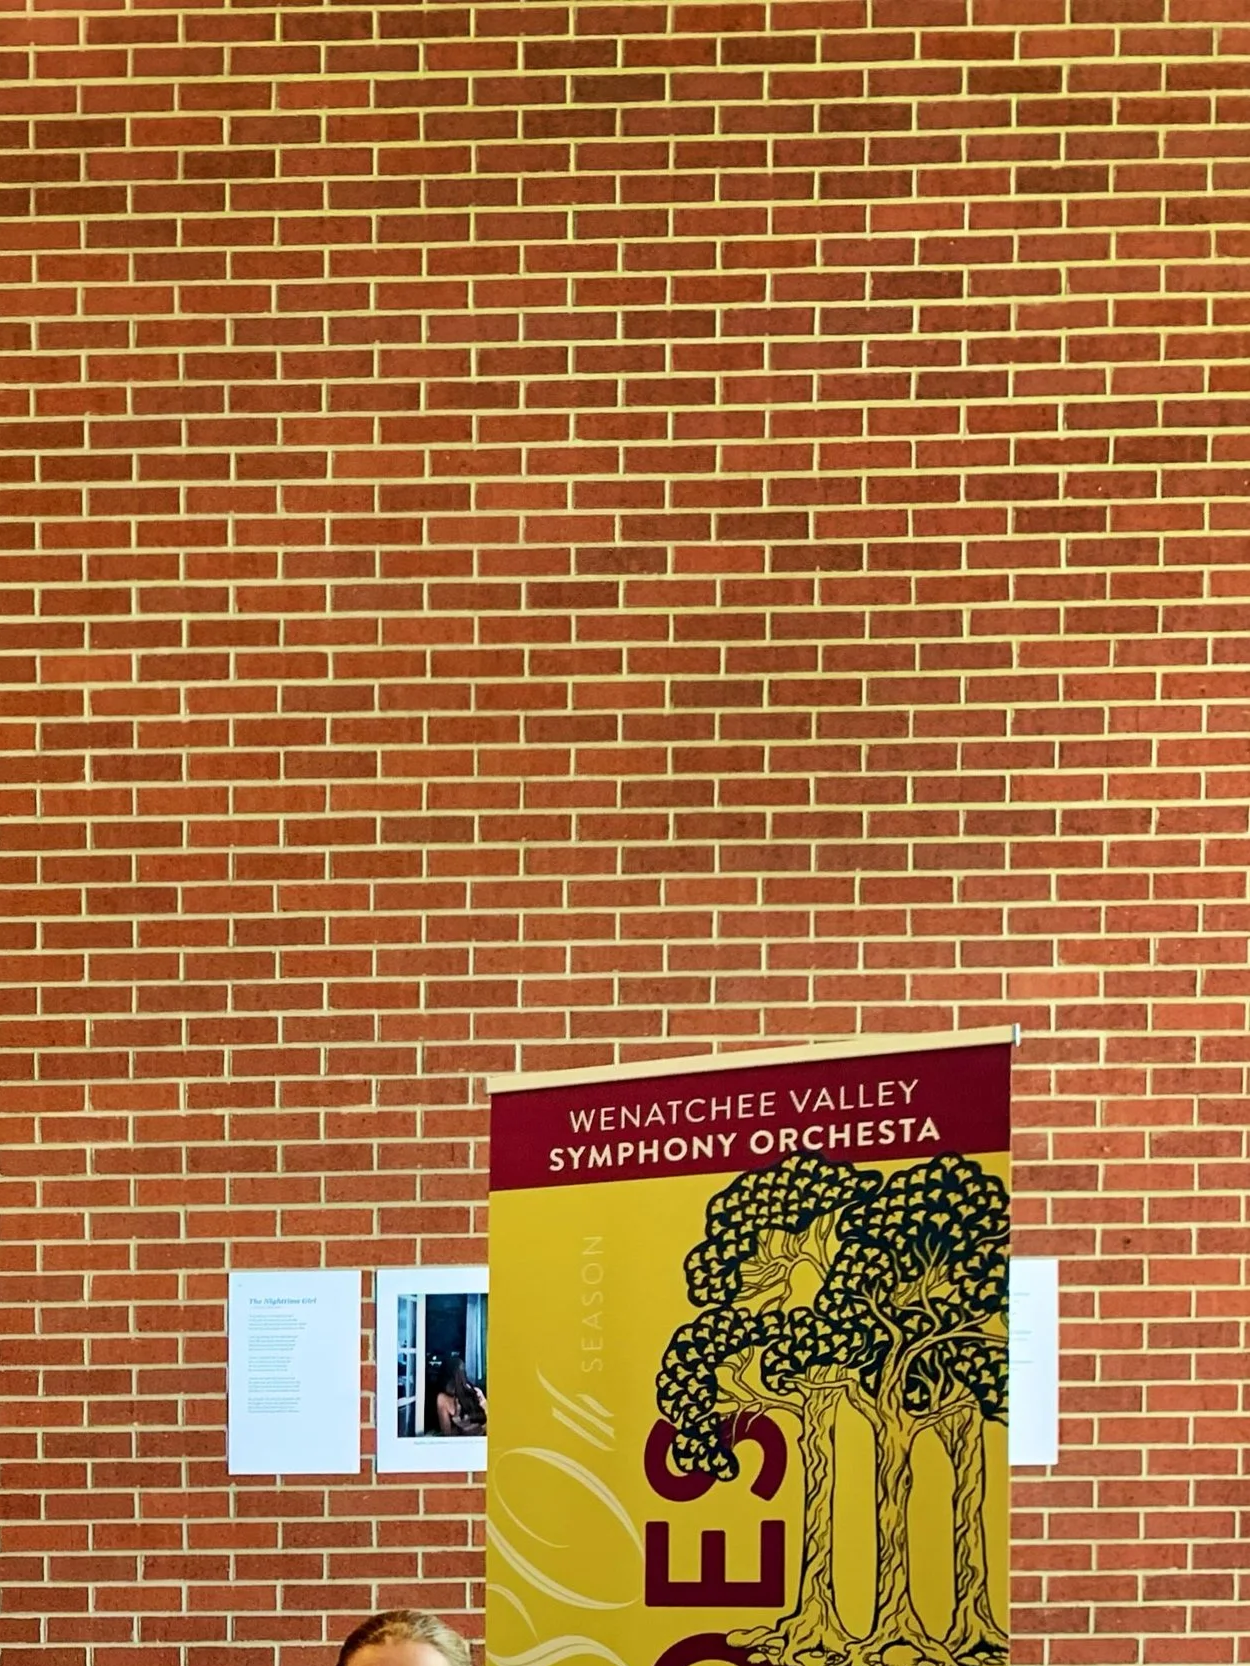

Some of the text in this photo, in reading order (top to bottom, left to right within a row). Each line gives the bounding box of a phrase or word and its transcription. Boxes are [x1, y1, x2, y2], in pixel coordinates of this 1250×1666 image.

[570, 1079, 919, 1134] WENATCHEE VALLEY
[548, 1116, 941, 1172] SYMPHONY ORCHESTA
[580, 1234, 605, 1374] SEASON
